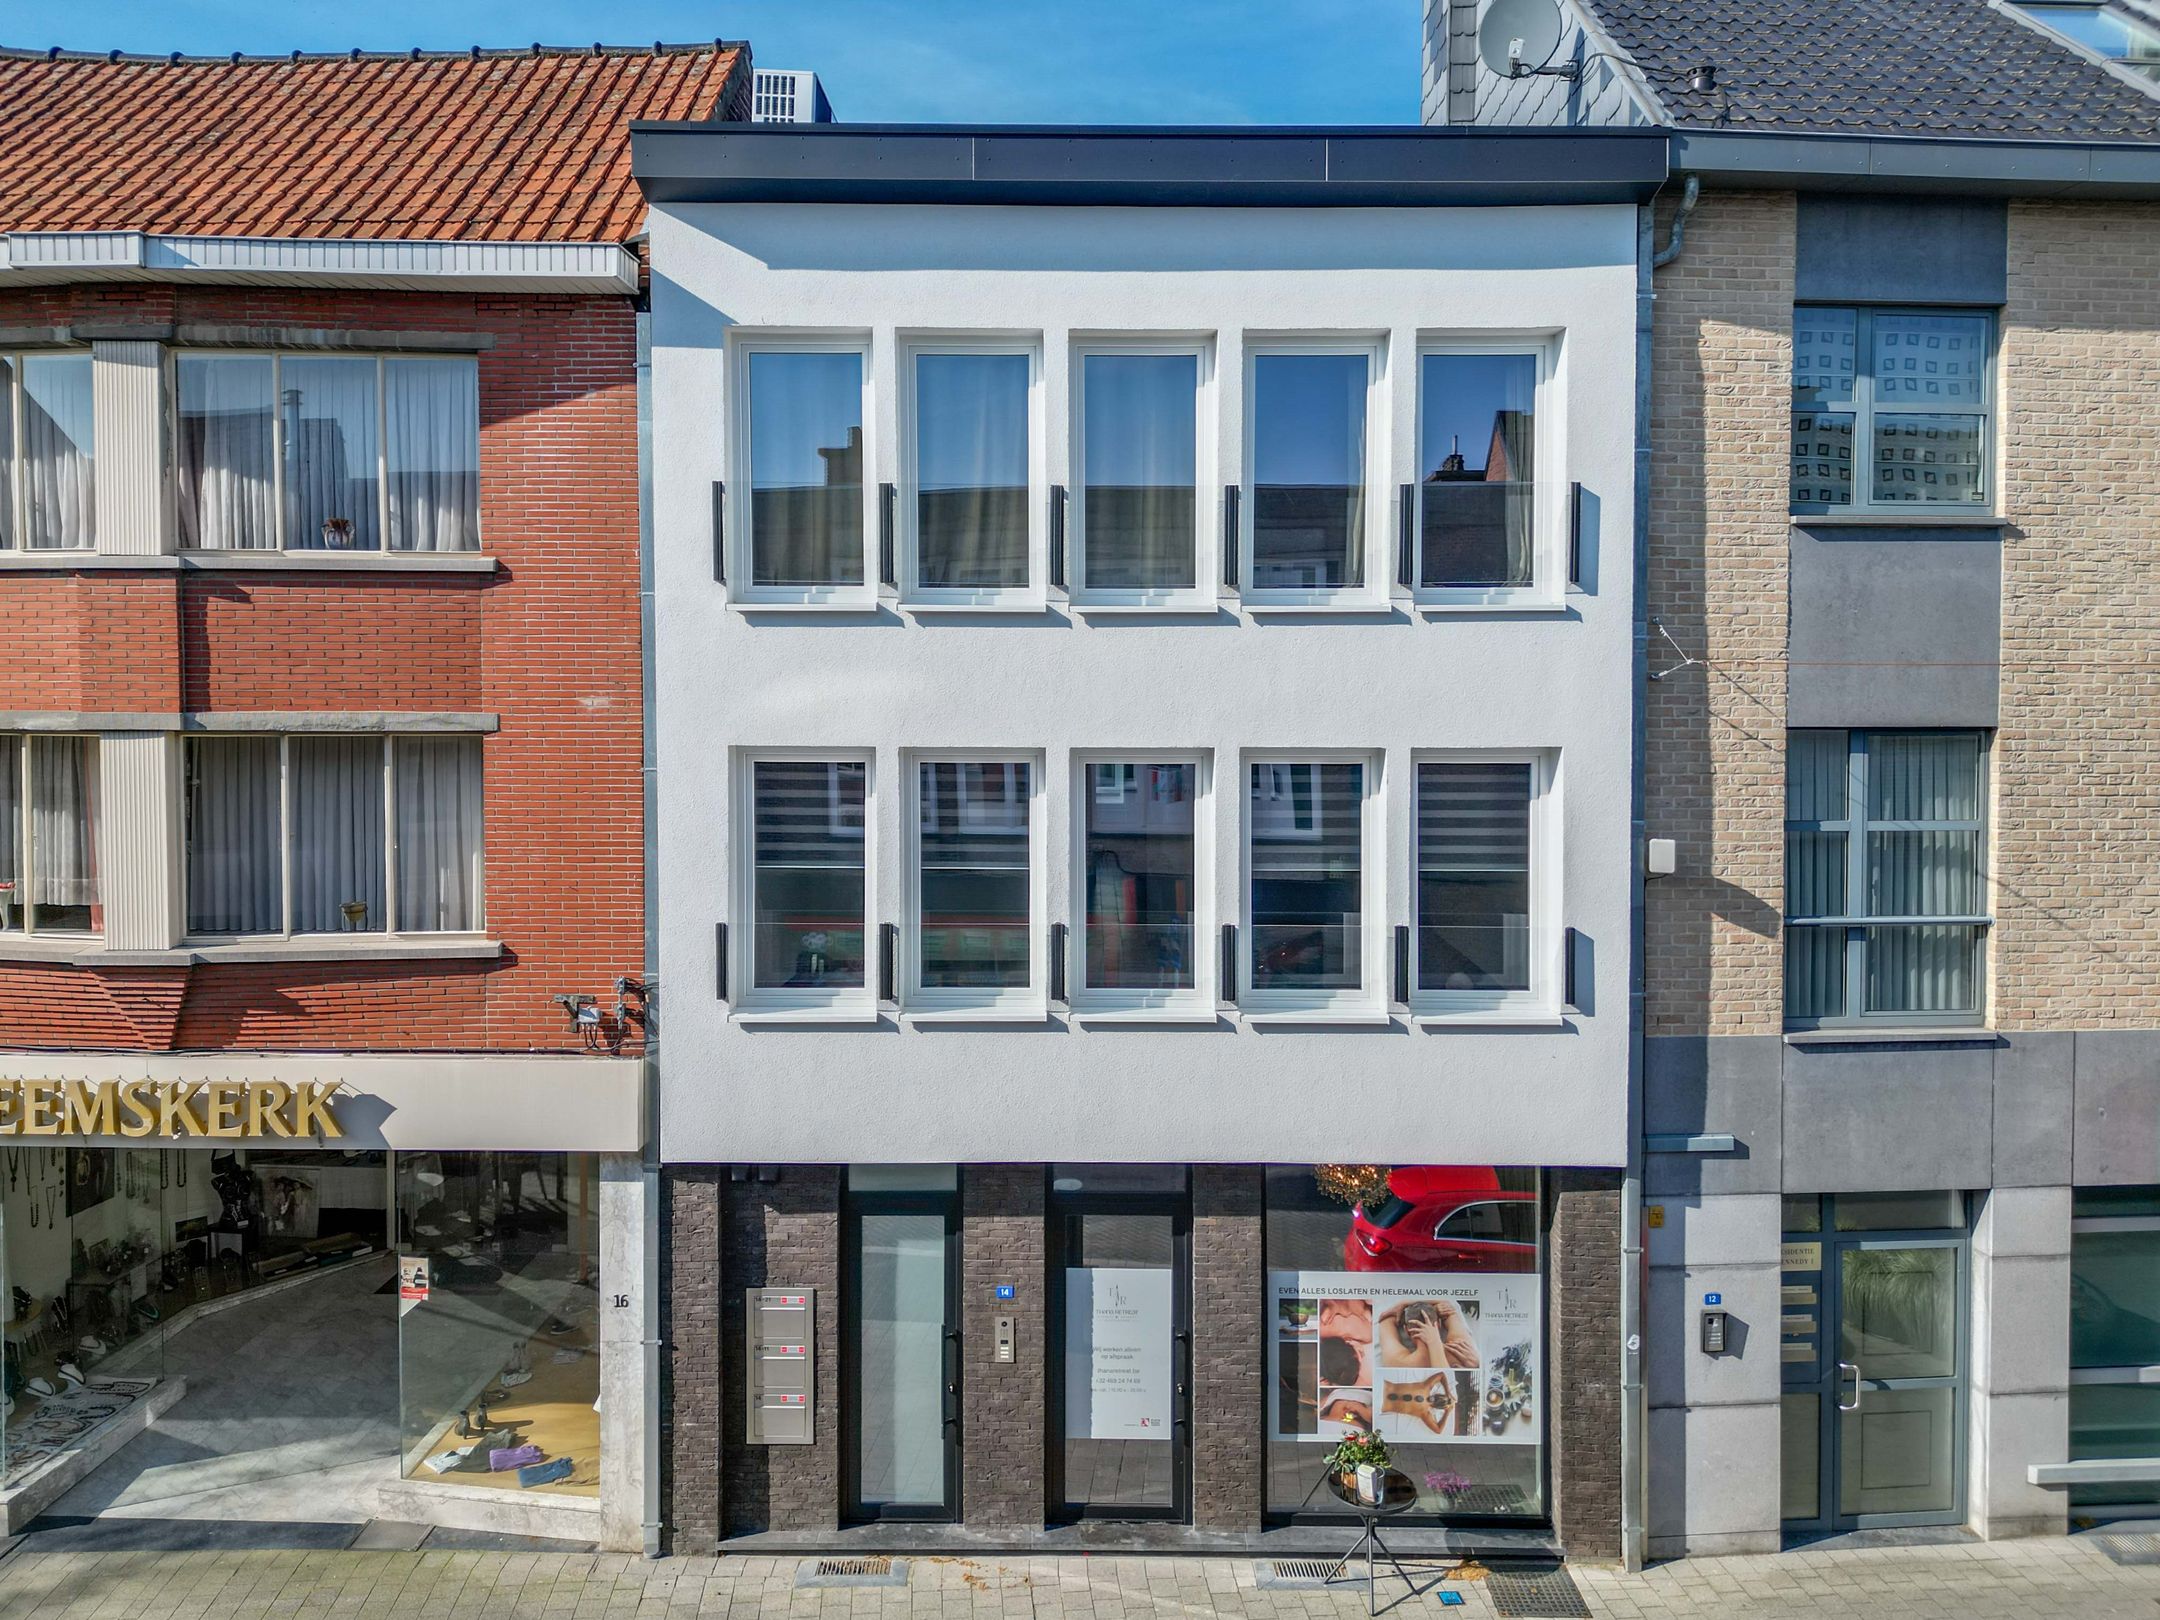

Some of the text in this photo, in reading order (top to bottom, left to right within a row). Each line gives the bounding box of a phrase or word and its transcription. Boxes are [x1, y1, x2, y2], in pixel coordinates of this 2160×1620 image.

[1001, 1288, 1009, 1296] 14
[1279, 1287, 1299, 1295] EVEN
[1301, 1287, 1326, 1295] ALLES
[1327, 1287, 1368, 1296] LOSLATEN
[1369, 1288, 1380, 1296] EN
[1382, 1288, 1425, 1296] HELEMAAL
[1450, 1289, 1479, 1297] JEZELF
[613, 1294, 629, 1308] 16
[1708, 1295, 1717, 1303] 12
